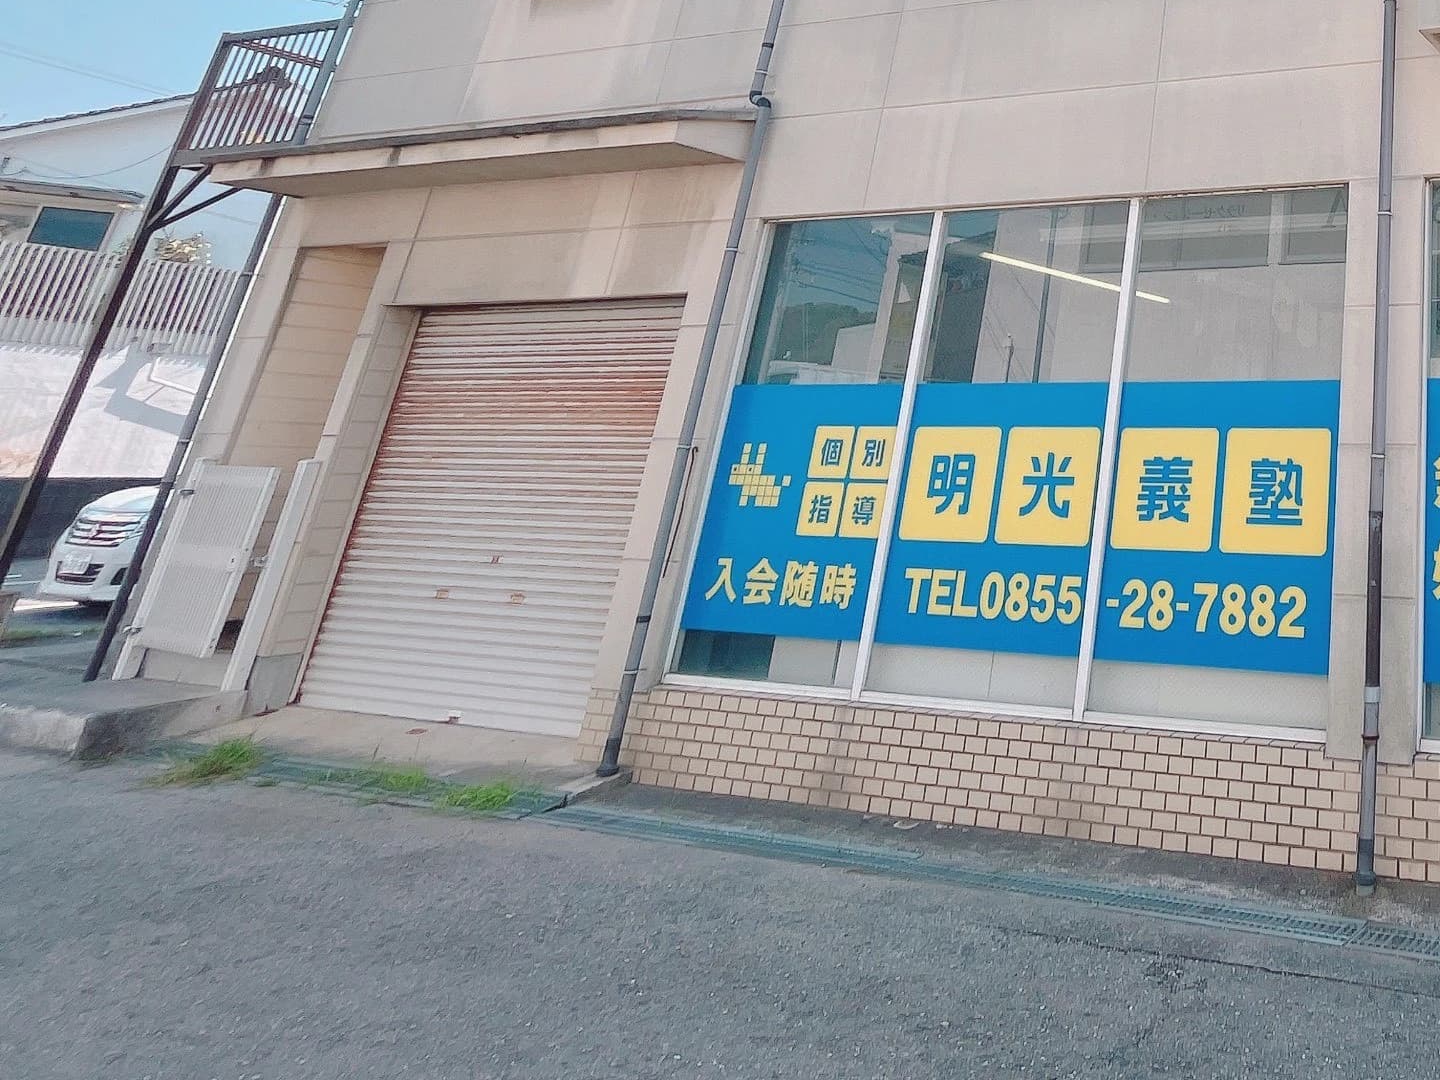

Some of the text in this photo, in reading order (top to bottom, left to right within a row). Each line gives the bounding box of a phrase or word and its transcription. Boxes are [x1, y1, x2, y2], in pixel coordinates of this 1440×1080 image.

[820, 437, 886, 468] 個別
[807, 494, 878, 526] 指導
[926, 451, 1305, 527] 明光義塾
[704, 557, 858, 610] 入会随時
